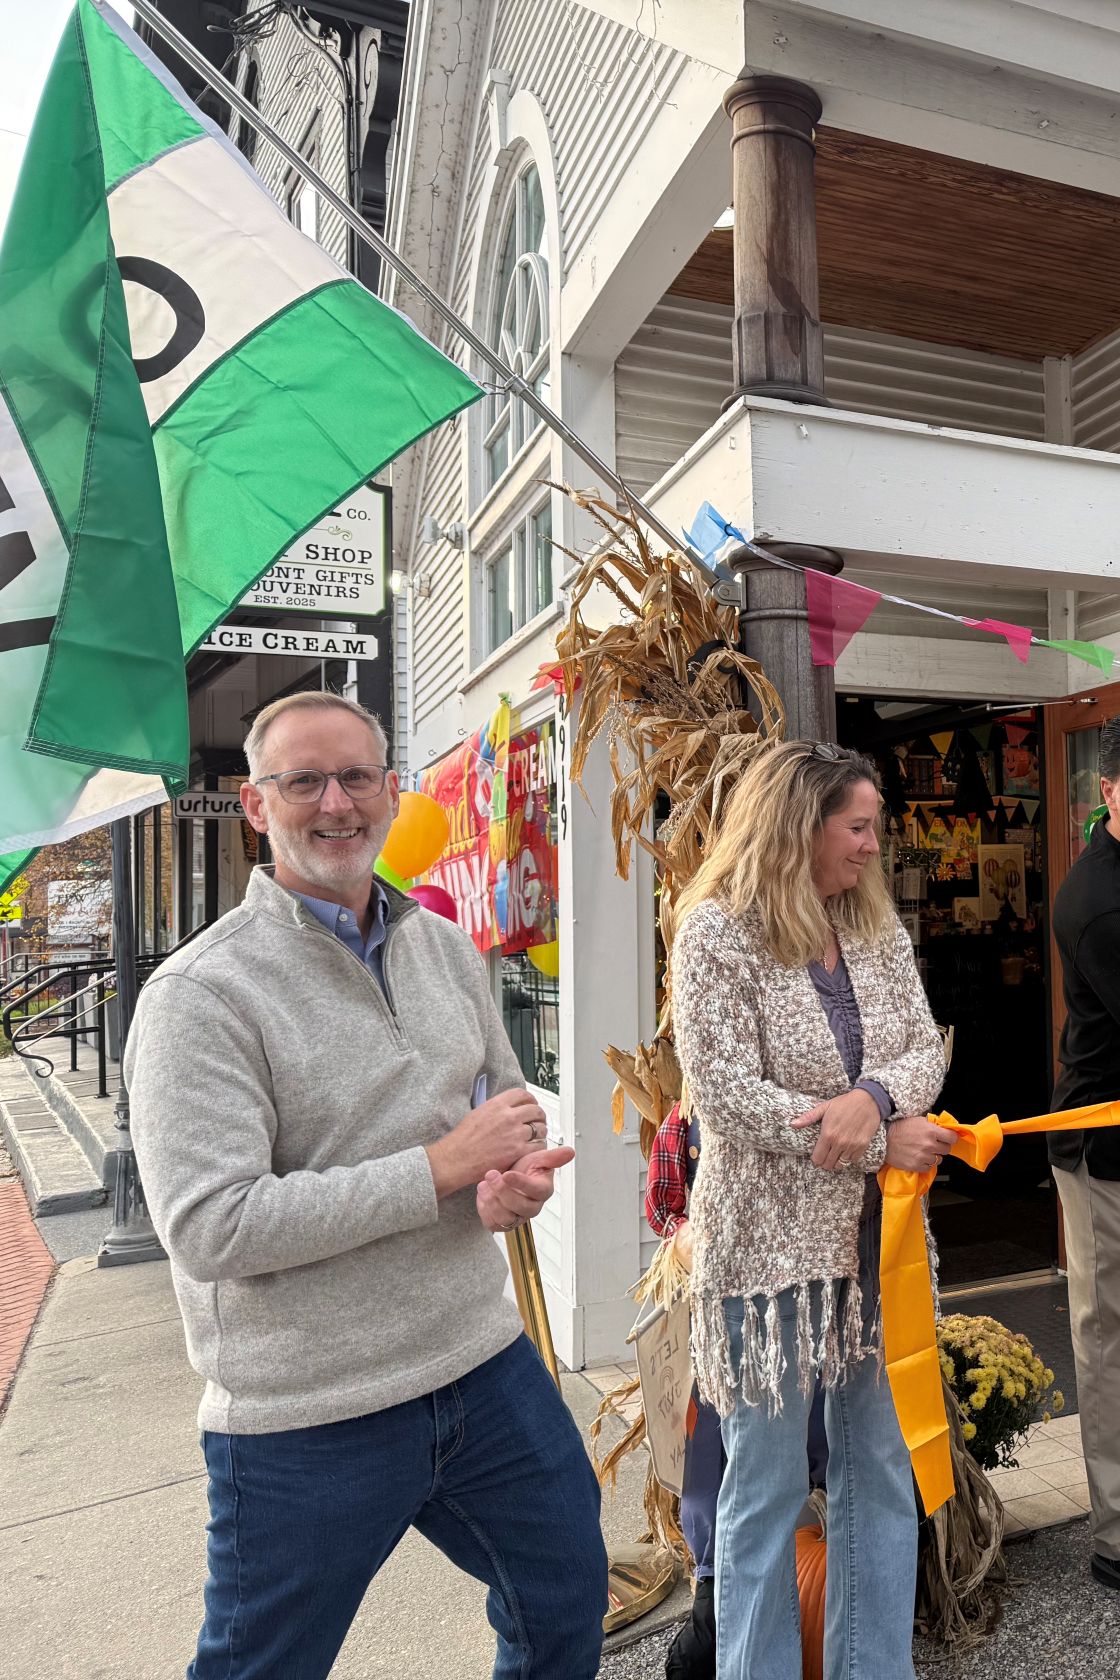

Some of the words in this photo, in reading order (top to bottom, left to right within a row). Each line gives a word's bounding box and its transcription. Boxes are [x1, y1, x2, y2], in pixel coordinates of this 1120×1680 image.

[346, 508, 371, 521] CO.
[305, 543, 373, 564] SHOP
[315, 569, 375, 586] GIFTS
[251, 580, 360, 599] OUVENIRS
[253, 595, 282, 605] EST.
[286, 597, 316, 607] 2025
[204, 630, 252, 648] ICE
[262, 632, 367, 654] CREAM
